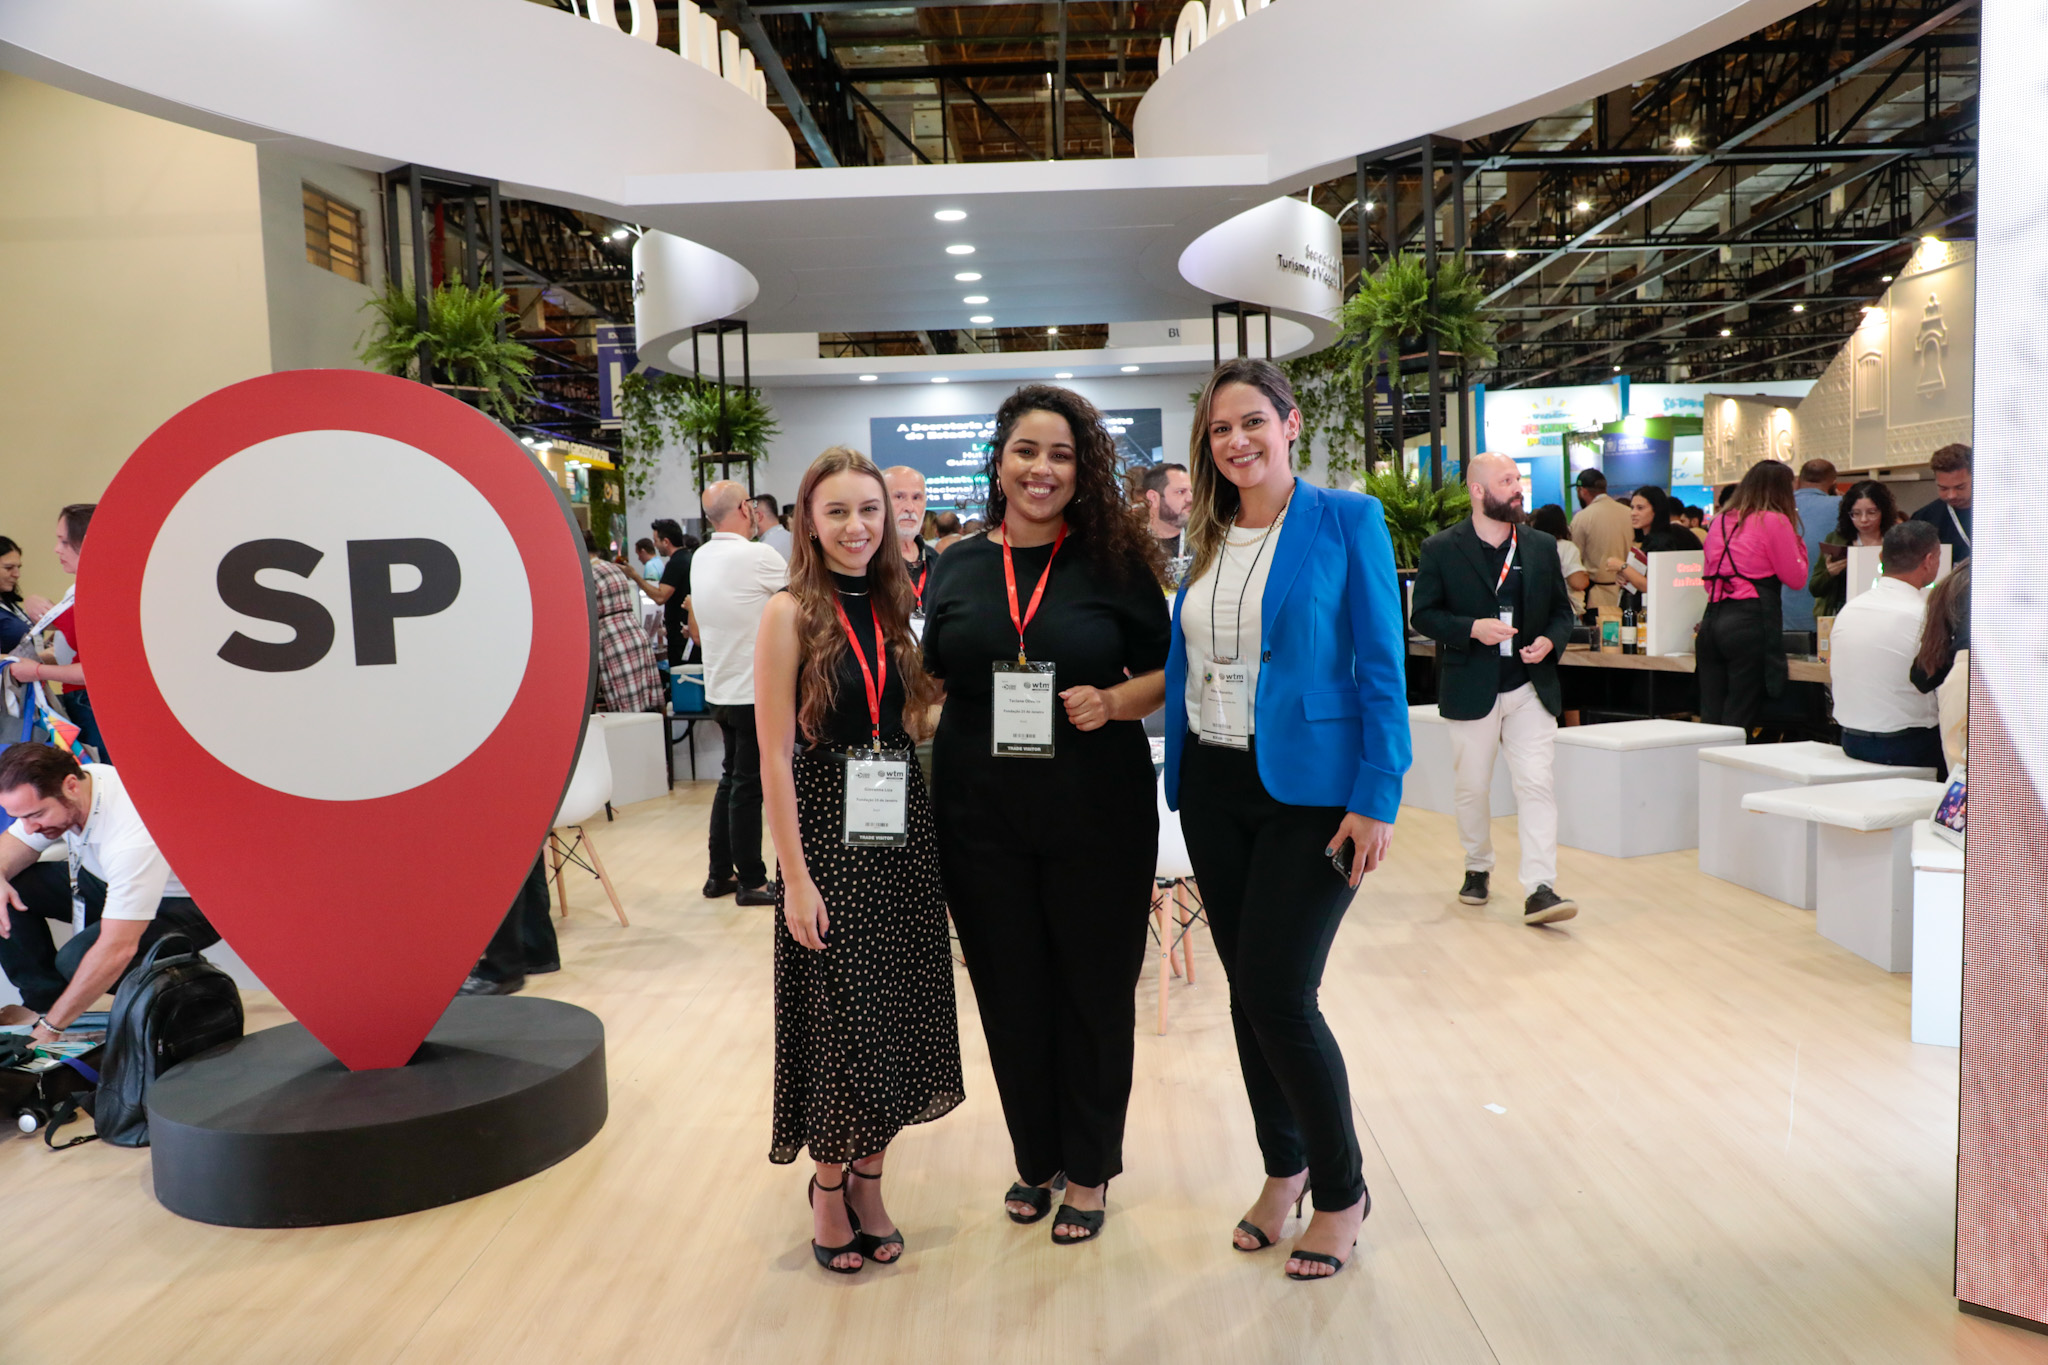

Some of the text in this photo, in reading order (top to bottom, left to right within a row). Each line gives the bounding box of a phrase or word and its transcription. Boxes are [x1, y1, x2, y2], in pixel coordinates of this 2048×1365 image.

[1278, 254, 1310, 274] Turismo
[897, 424, 909, 432] A
[217, 537, 461, 673] SP
